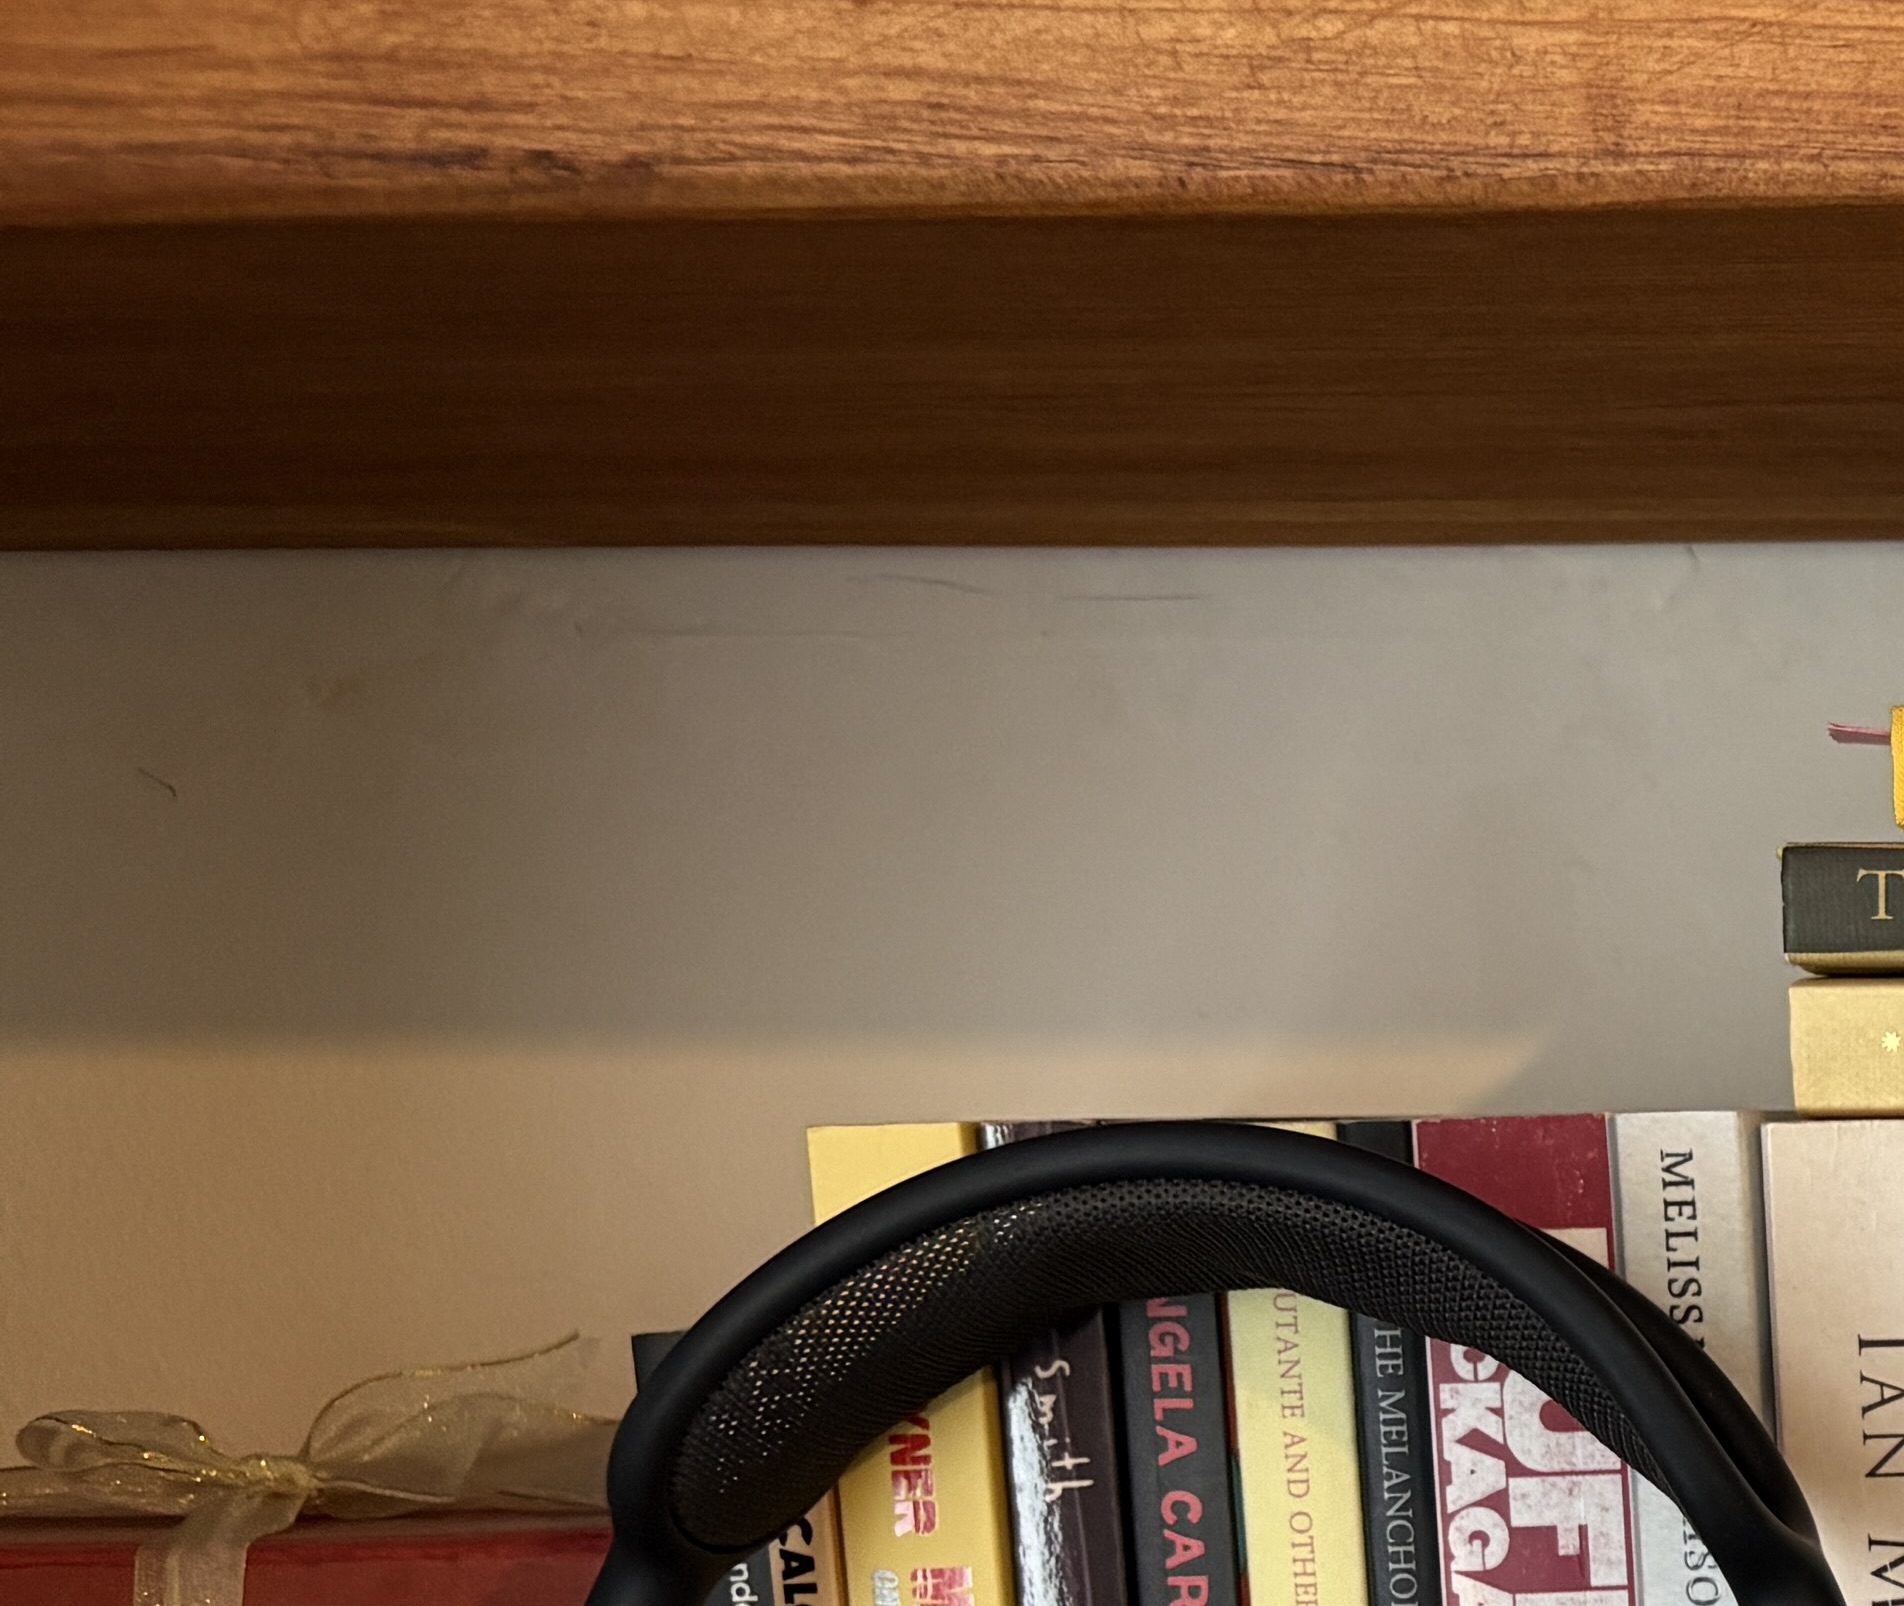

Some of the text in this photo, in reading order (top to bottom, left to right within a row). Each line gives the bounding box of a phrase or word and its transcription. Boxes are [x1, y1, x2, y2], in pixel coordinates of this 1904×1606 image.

[1660, 1148, 1705, 1348] MELISS
[1144, 1296, 1197, 1467] NGELA
[1273, 1292, 1307, 1420] UTANTE
[1373, 1327, 1404, 1379] HE
[1282, 1430, 1311, 1501] AND
